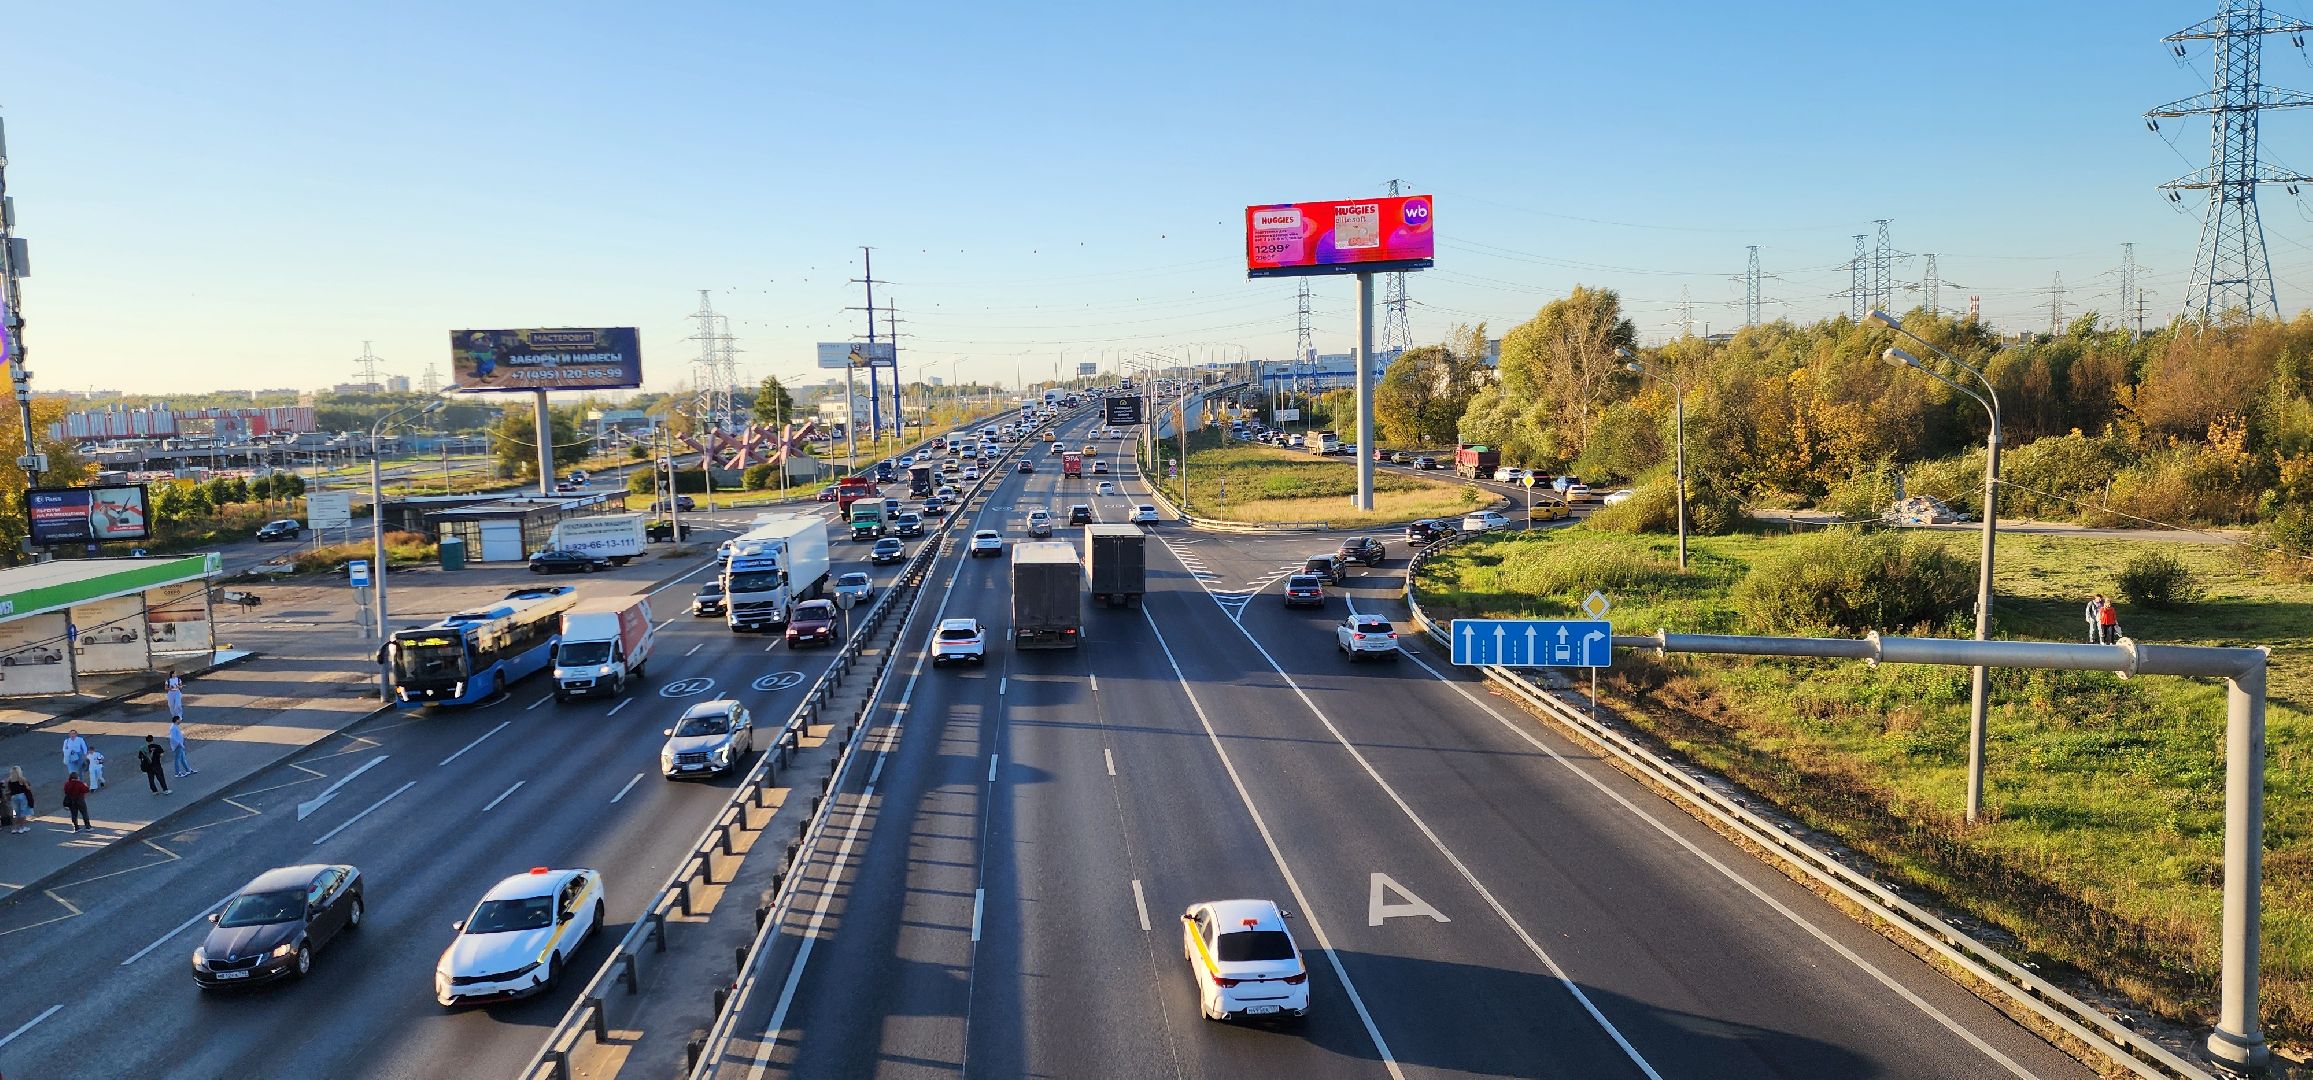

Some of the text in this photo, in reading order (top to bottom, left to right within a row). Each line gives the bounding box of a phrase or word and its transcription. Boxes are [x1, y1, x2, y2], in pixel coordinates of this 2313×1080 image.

[1335, 206, 1375, 216] HUGGIES
[1405, 205, 1428, 218] wb
[1261, 216, 1294, 225] HUGGIES
[534, 334, 592, 342] МАСТЕРОВИТ
[509, 353, 622, 364] ЗАБОРЫ И НАВЕСЫ
[511, 368, 623, 380] +7 (495) 120-66-99
